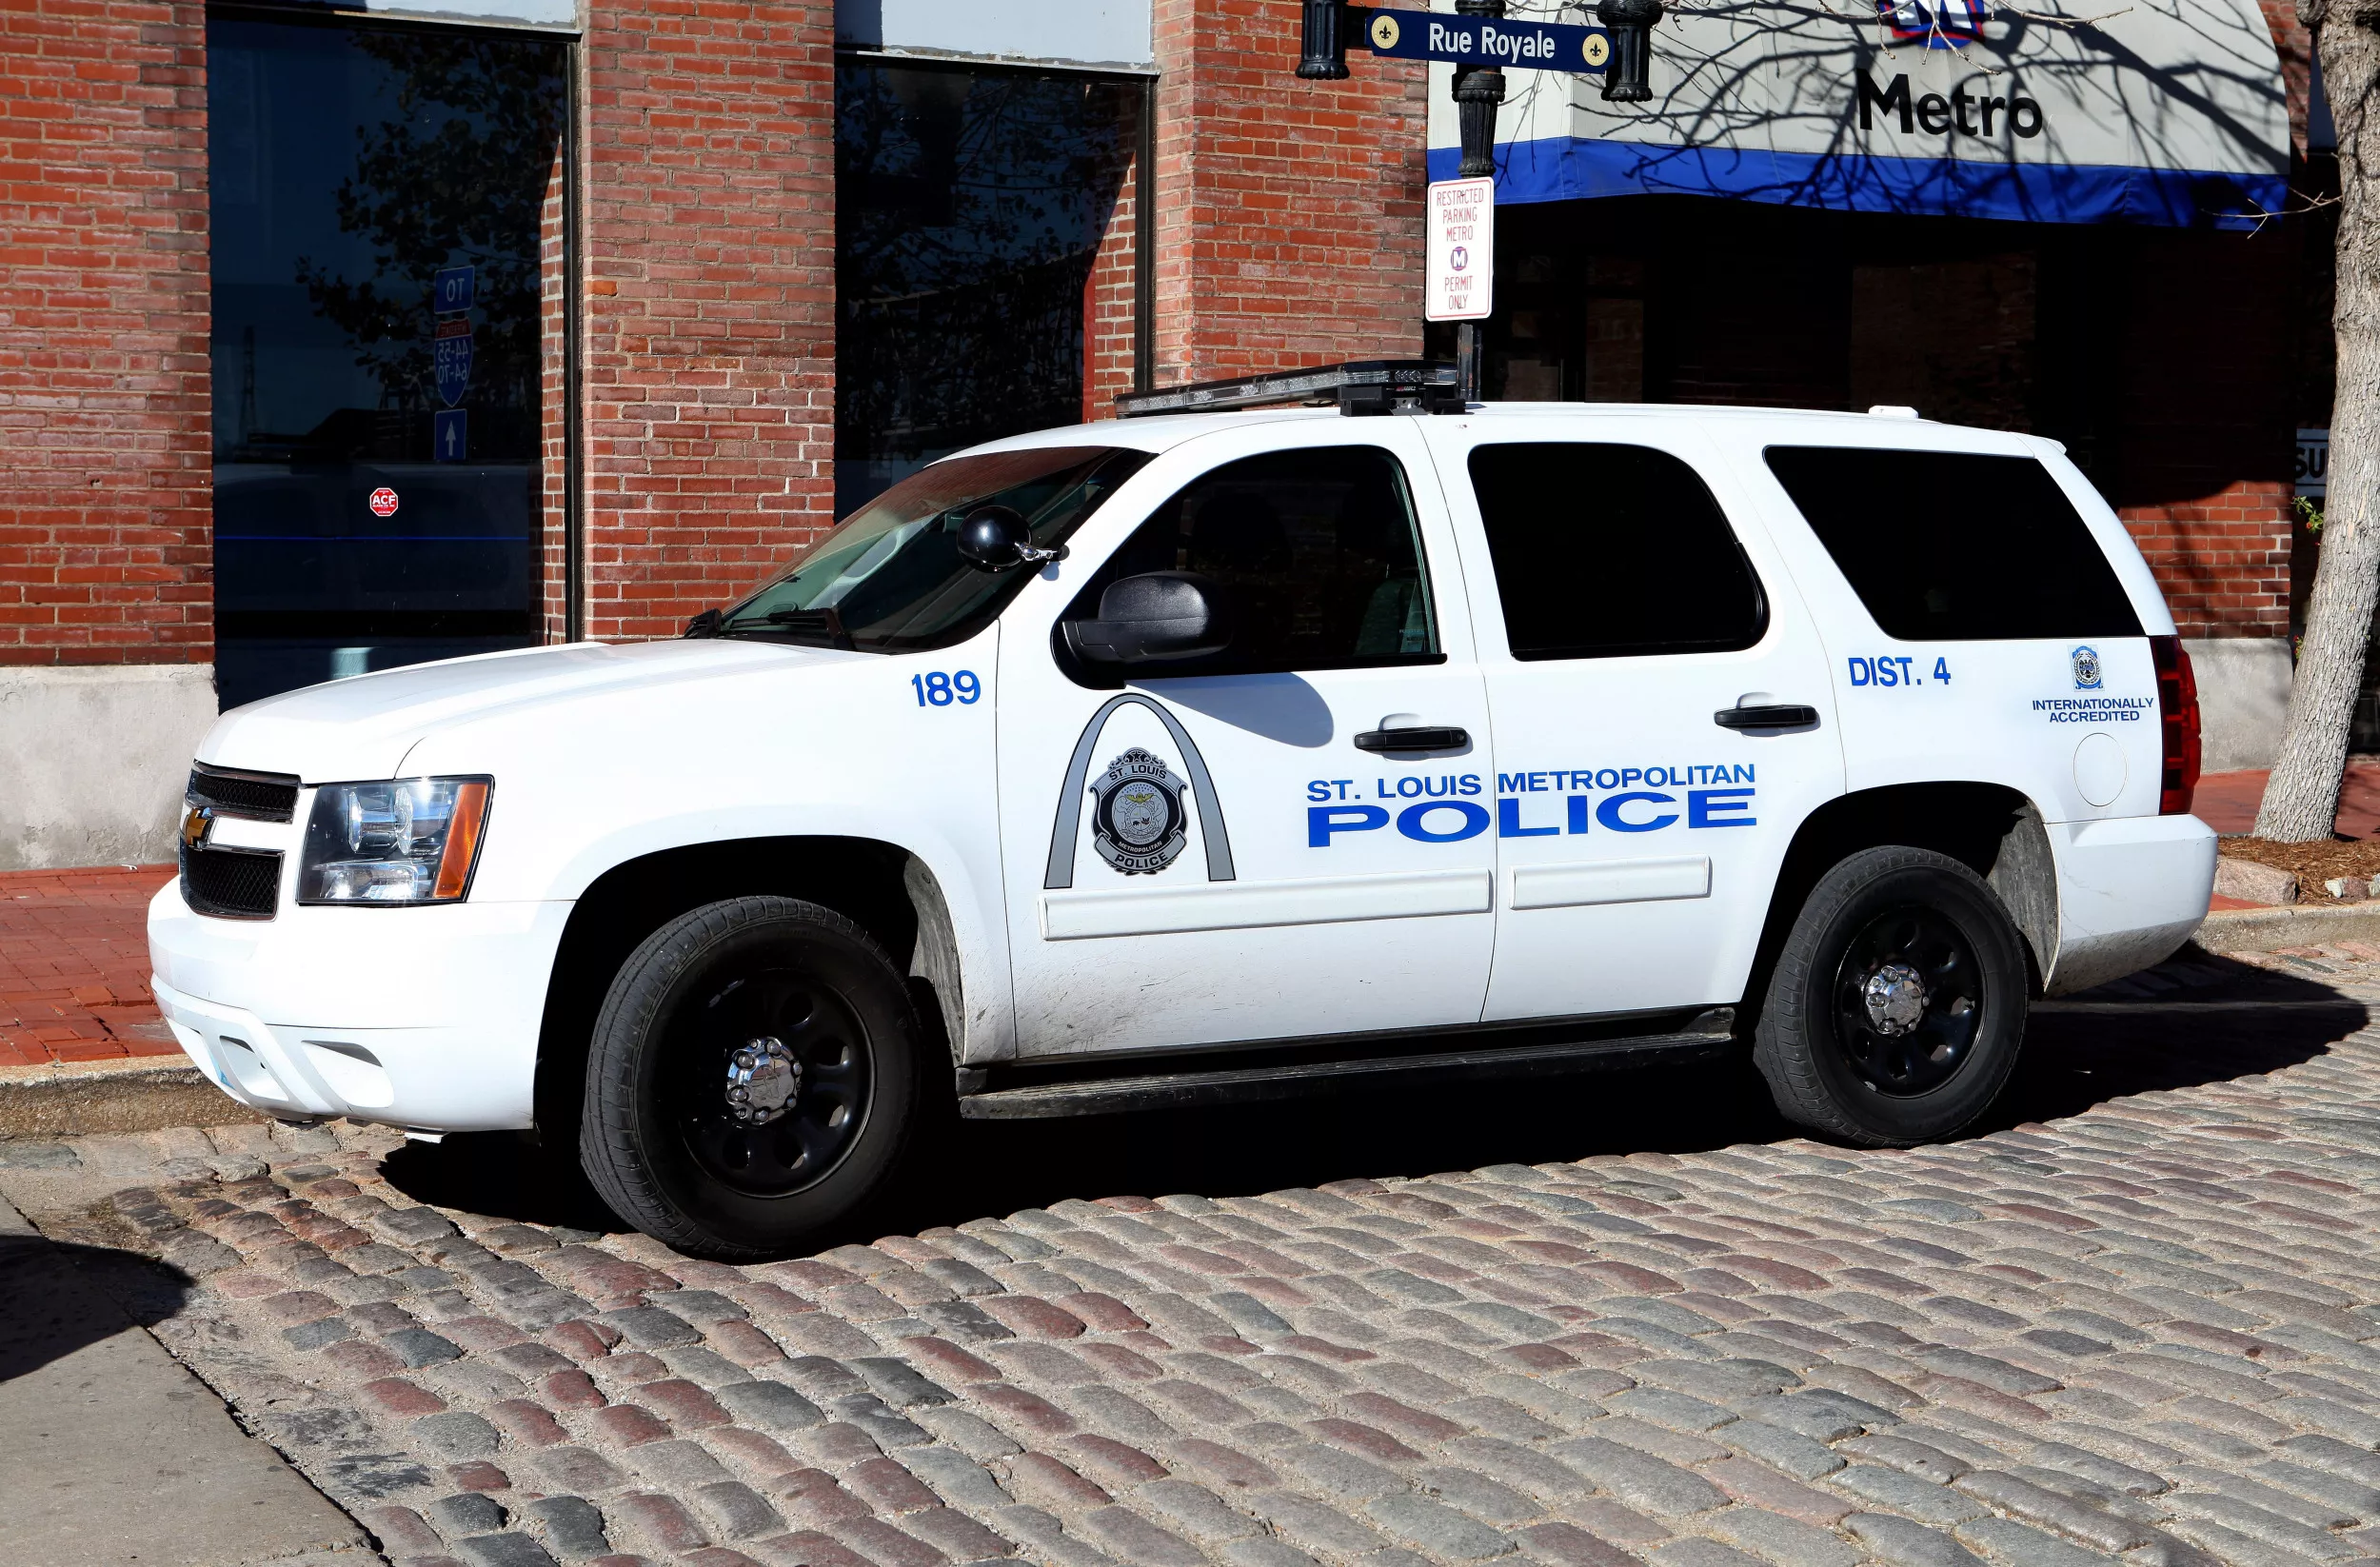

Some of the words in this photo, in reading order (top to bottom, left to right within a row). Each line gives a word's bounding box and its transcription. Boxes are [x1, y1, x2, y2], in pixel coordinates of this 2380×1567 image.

[1429, 22, 1473, 53] Rue
[1481, 26, 1556, 64] Royale
[1856, 68, 2043, 139] Metro
[1437, 188, 1484, 207] RESTRICTED
[1442, 207, 1478, 225] PARKING
[1446, 225, 1474, 242] METRO
[1453, 249, 1466, 268] M
[1444, 275, 1474, 292] PERMIT
[1448, 293, 1469, 310] ONLY
[1848, 656, 1922, 686] DIST.
[1933, 656, 1952, 685] 4
[911, 669, 982, 707] 189
[2032, 697, 2154, 711] INTERNATIONALLY
[2049, 710, 2140, 724] ACCREDITED
[1108, 767, 1127, 781] ST.
[1131, 764, 1167, 780] LOUIS
[1306, 780, 1361, 803] ST.
[1377, 774, 1482, 799] LOUIS
[1497, 764, 1755, 794] METROPOLITAN
[1307, 787, 1757, 848] POLICE
[1118, 840, 1163, 853] METROPOLITAN
[1114, 851, 1169, 868] POLICE
